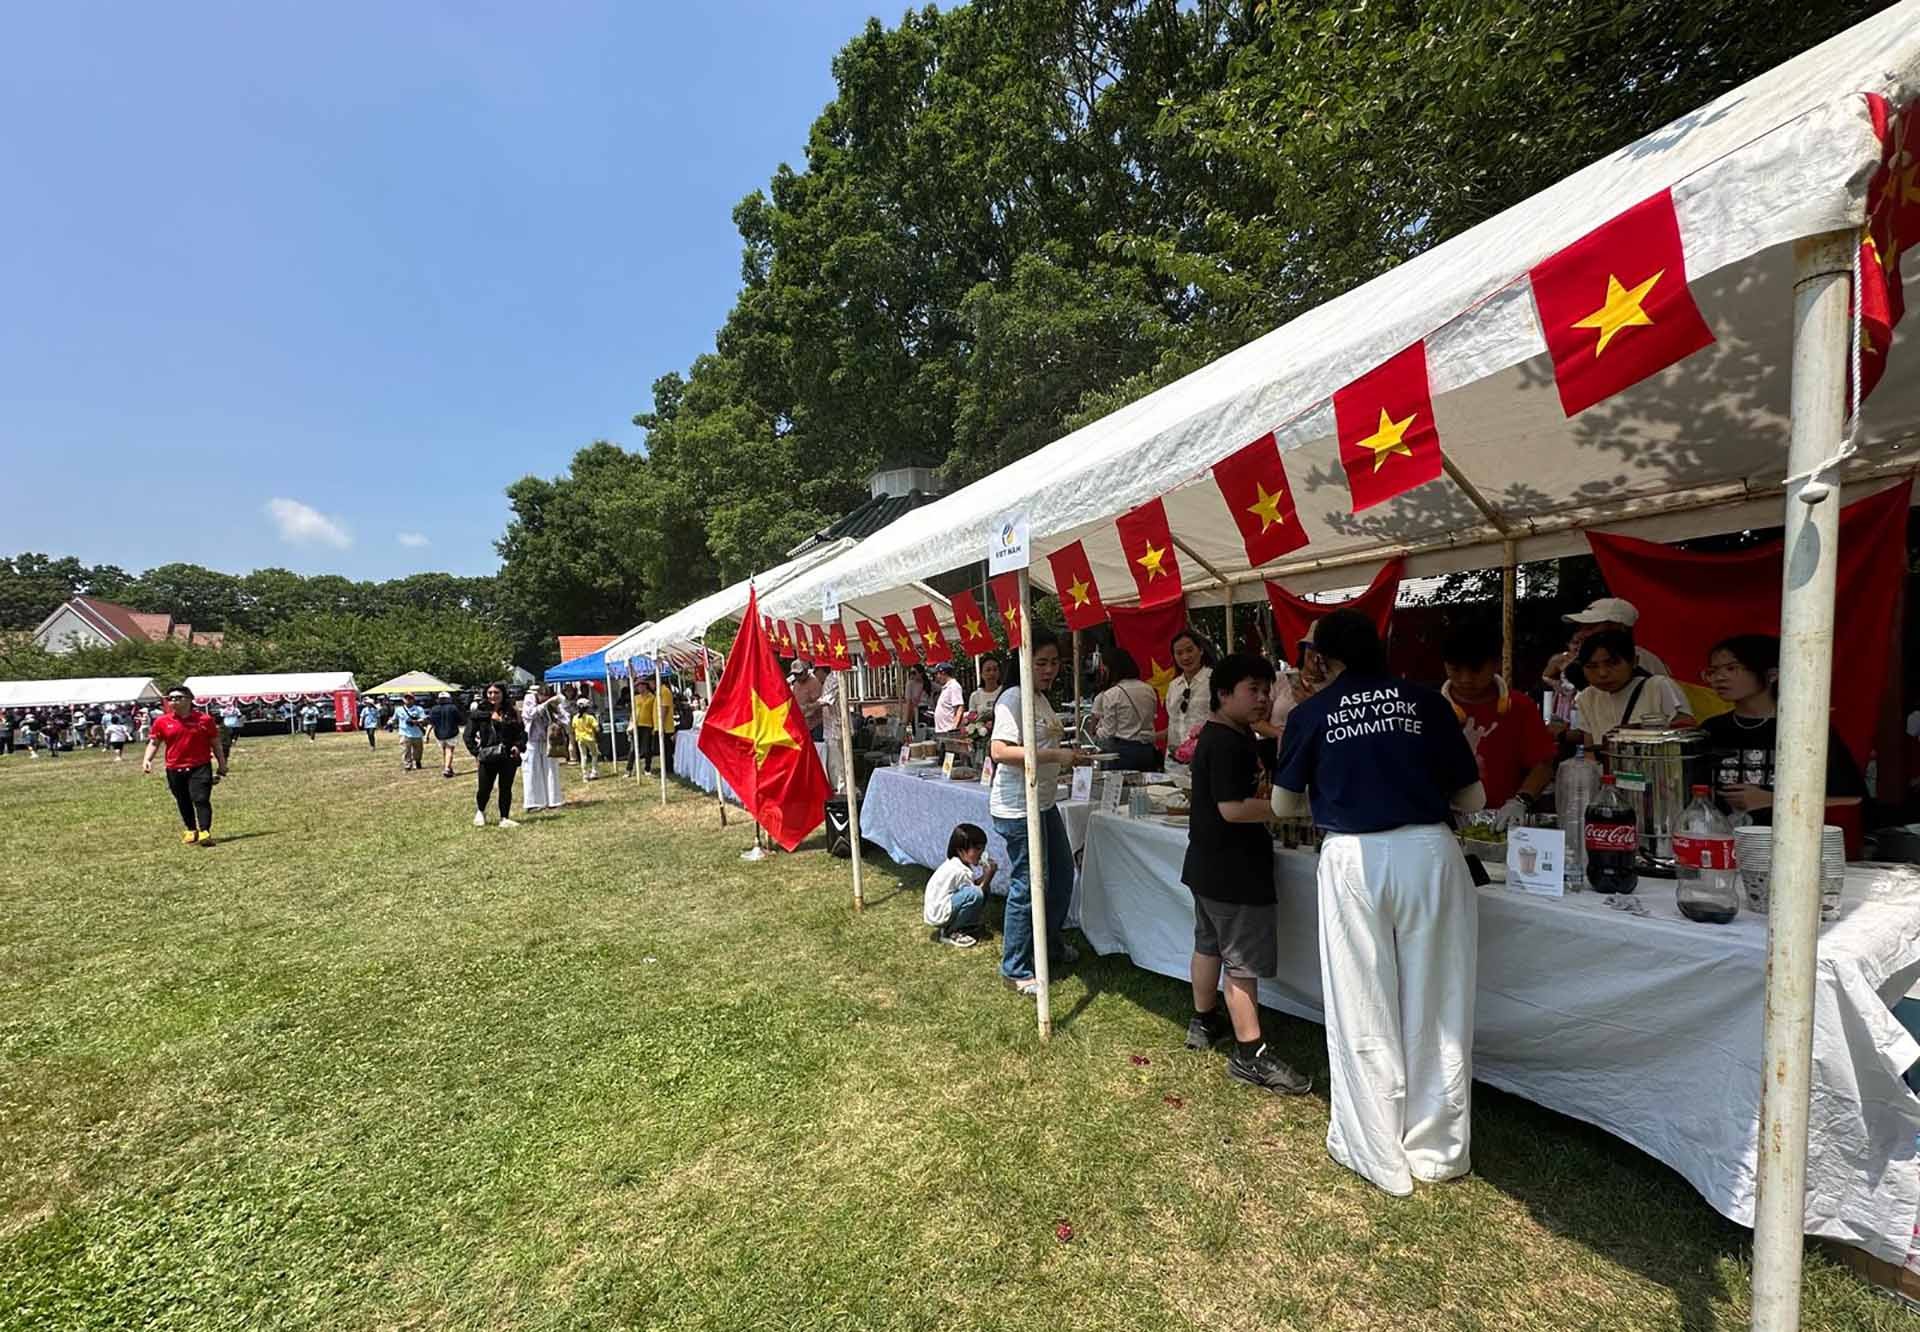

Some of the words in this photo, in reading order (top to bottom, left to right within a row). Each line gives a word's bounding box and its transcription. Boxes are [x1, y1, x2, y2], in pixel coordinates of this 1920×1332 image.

[1340, 688, 1399, 707] ASEAN
[1327, 706, 1366, 726] NEW
[1371, 701, 1417, 716] YORK
[1326, 717, 1423, 743] COMMITTEE
[1584, 823, 1635, 843] Coca-Cola
